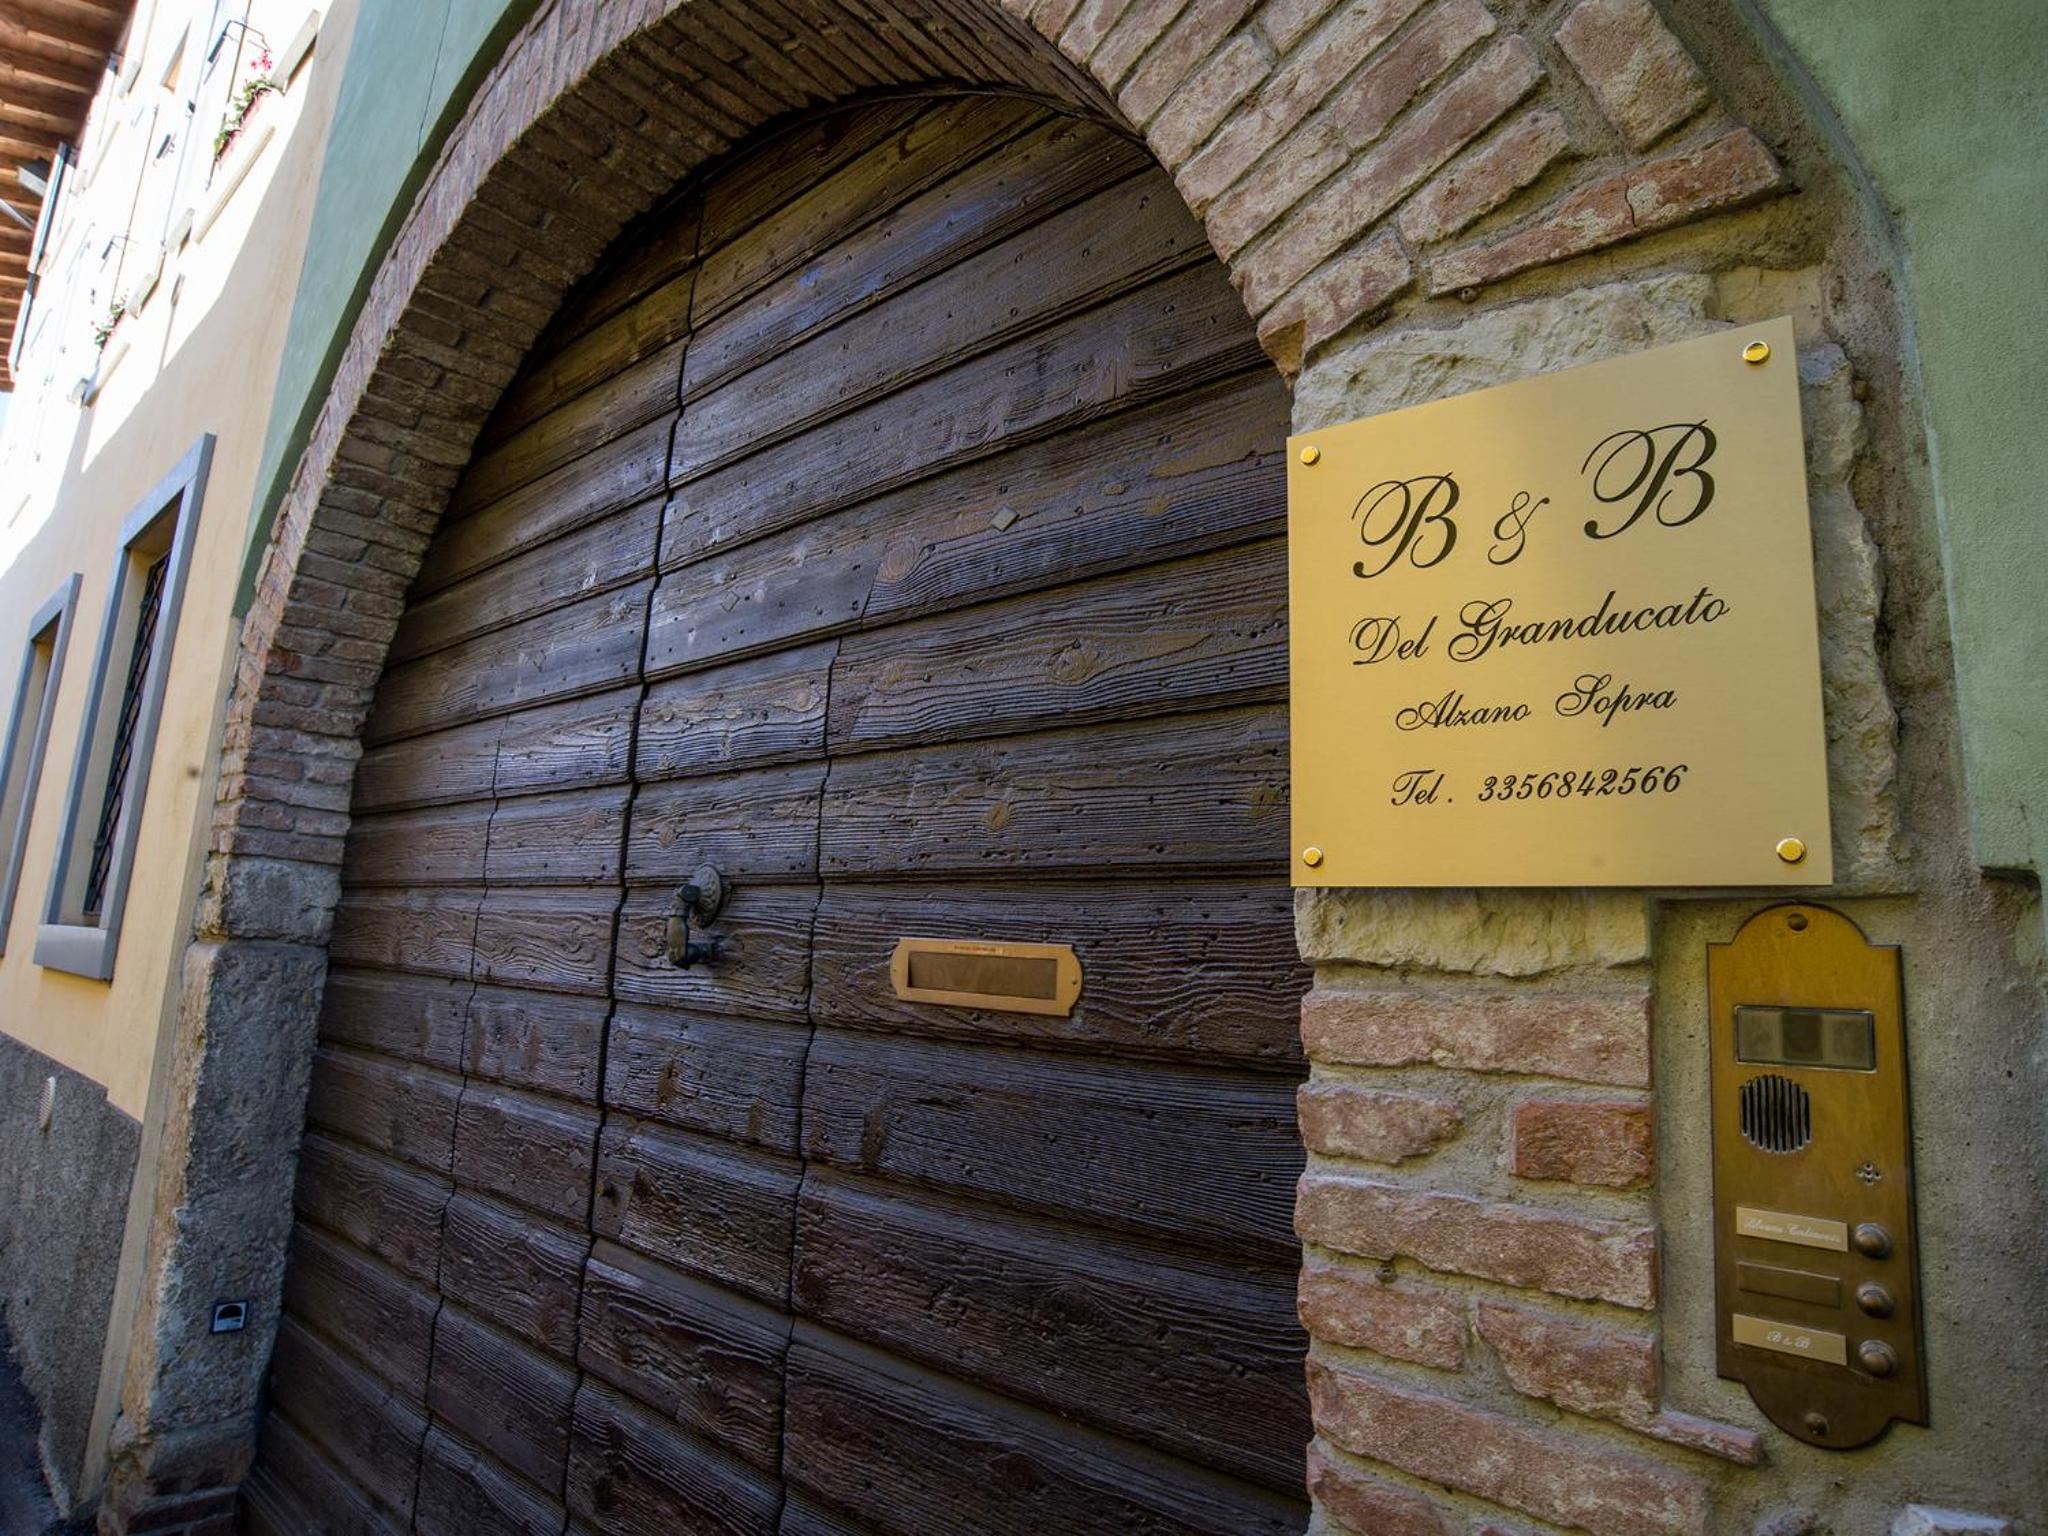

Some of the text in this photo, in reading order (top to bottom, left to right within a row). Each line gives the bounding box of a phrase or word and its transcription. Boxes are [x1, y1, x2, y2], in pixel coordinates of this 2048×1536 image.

[1351, 418, 1718, 579] B & B
[1348, 586, 1731, 666] Del Granducato
[1394, 673, 1678, 732] Alzano Sopra
[1477, 763, 1689, 803] 3356842566
